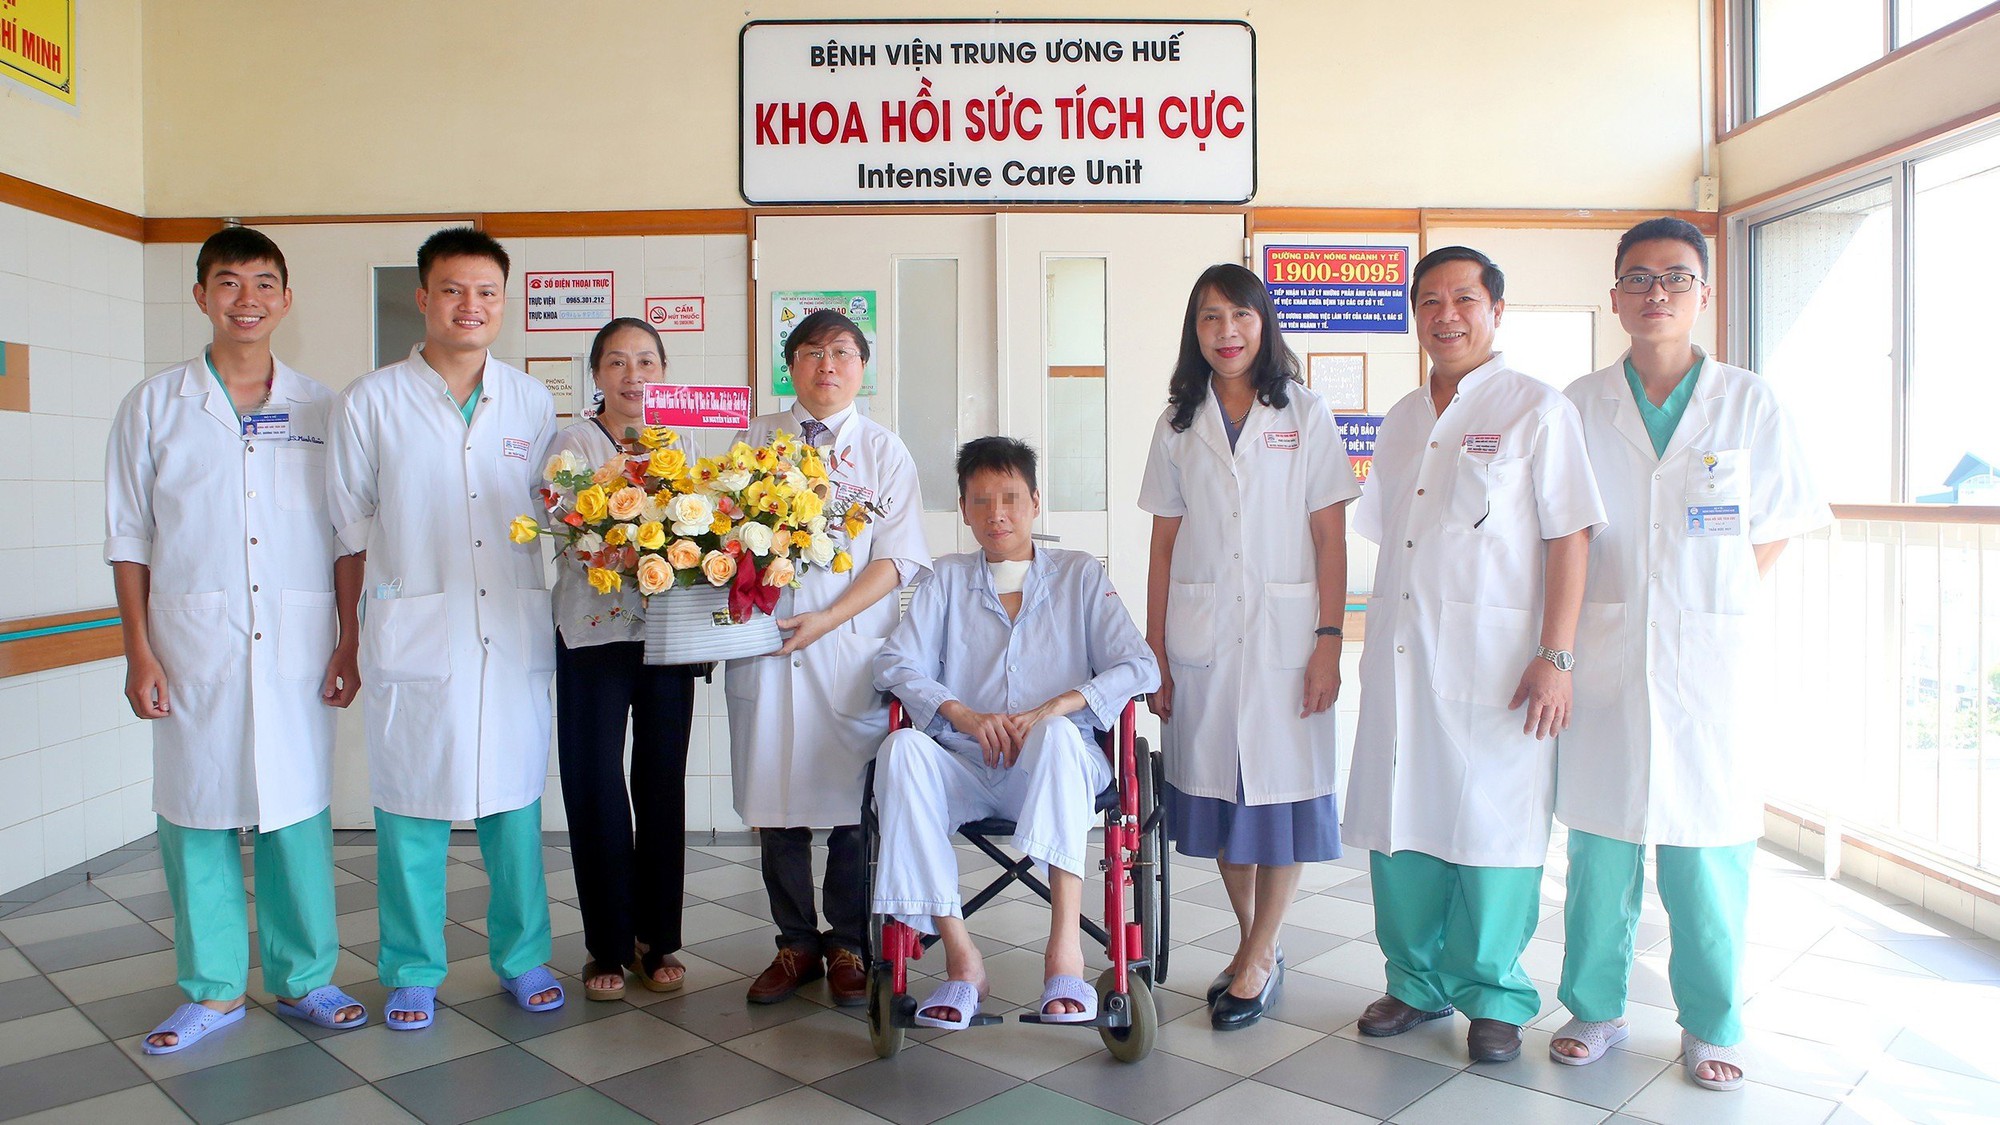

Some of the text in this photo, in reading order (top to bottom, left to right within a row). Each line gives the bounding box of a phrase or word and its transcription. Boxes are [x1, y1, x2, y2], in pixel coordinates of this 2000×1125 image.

[0, 17, 61, 74] HÍ MINH
[810, 31, 1185, 73] BỆNH VIỆN TRUNG ƯƠNG HUẾ
[755, 76, 1245, 151] KHOA HỒI SỨC TÍCH CỰC
[858, 159, 1143, 188] Intensive Care Unit
[1272, 251, 1301, 260] ĐƯỜNG
[1303, 251, 1321, 260] DÂY
[1323, 252, 1347, 260] NÓNG
[1349, 252, 1378, 261] NGÀNH
[1388, 251, 1400, 261] TẾ
[1273, 261, 1400, 283] 1900-9095
[554, 278, 570, 289] ĐIỆN
[571, 279, 591, 289] THOẠI
[592, 278, 609, 289] TRỰC
[543, 311, 557, 319] KHOA
[1349, 423, 1360, 437] ĐỘ
[1361, 422, 1374, 435] BẢO
[1348, 438, 1364, 453] ĐIỆN
